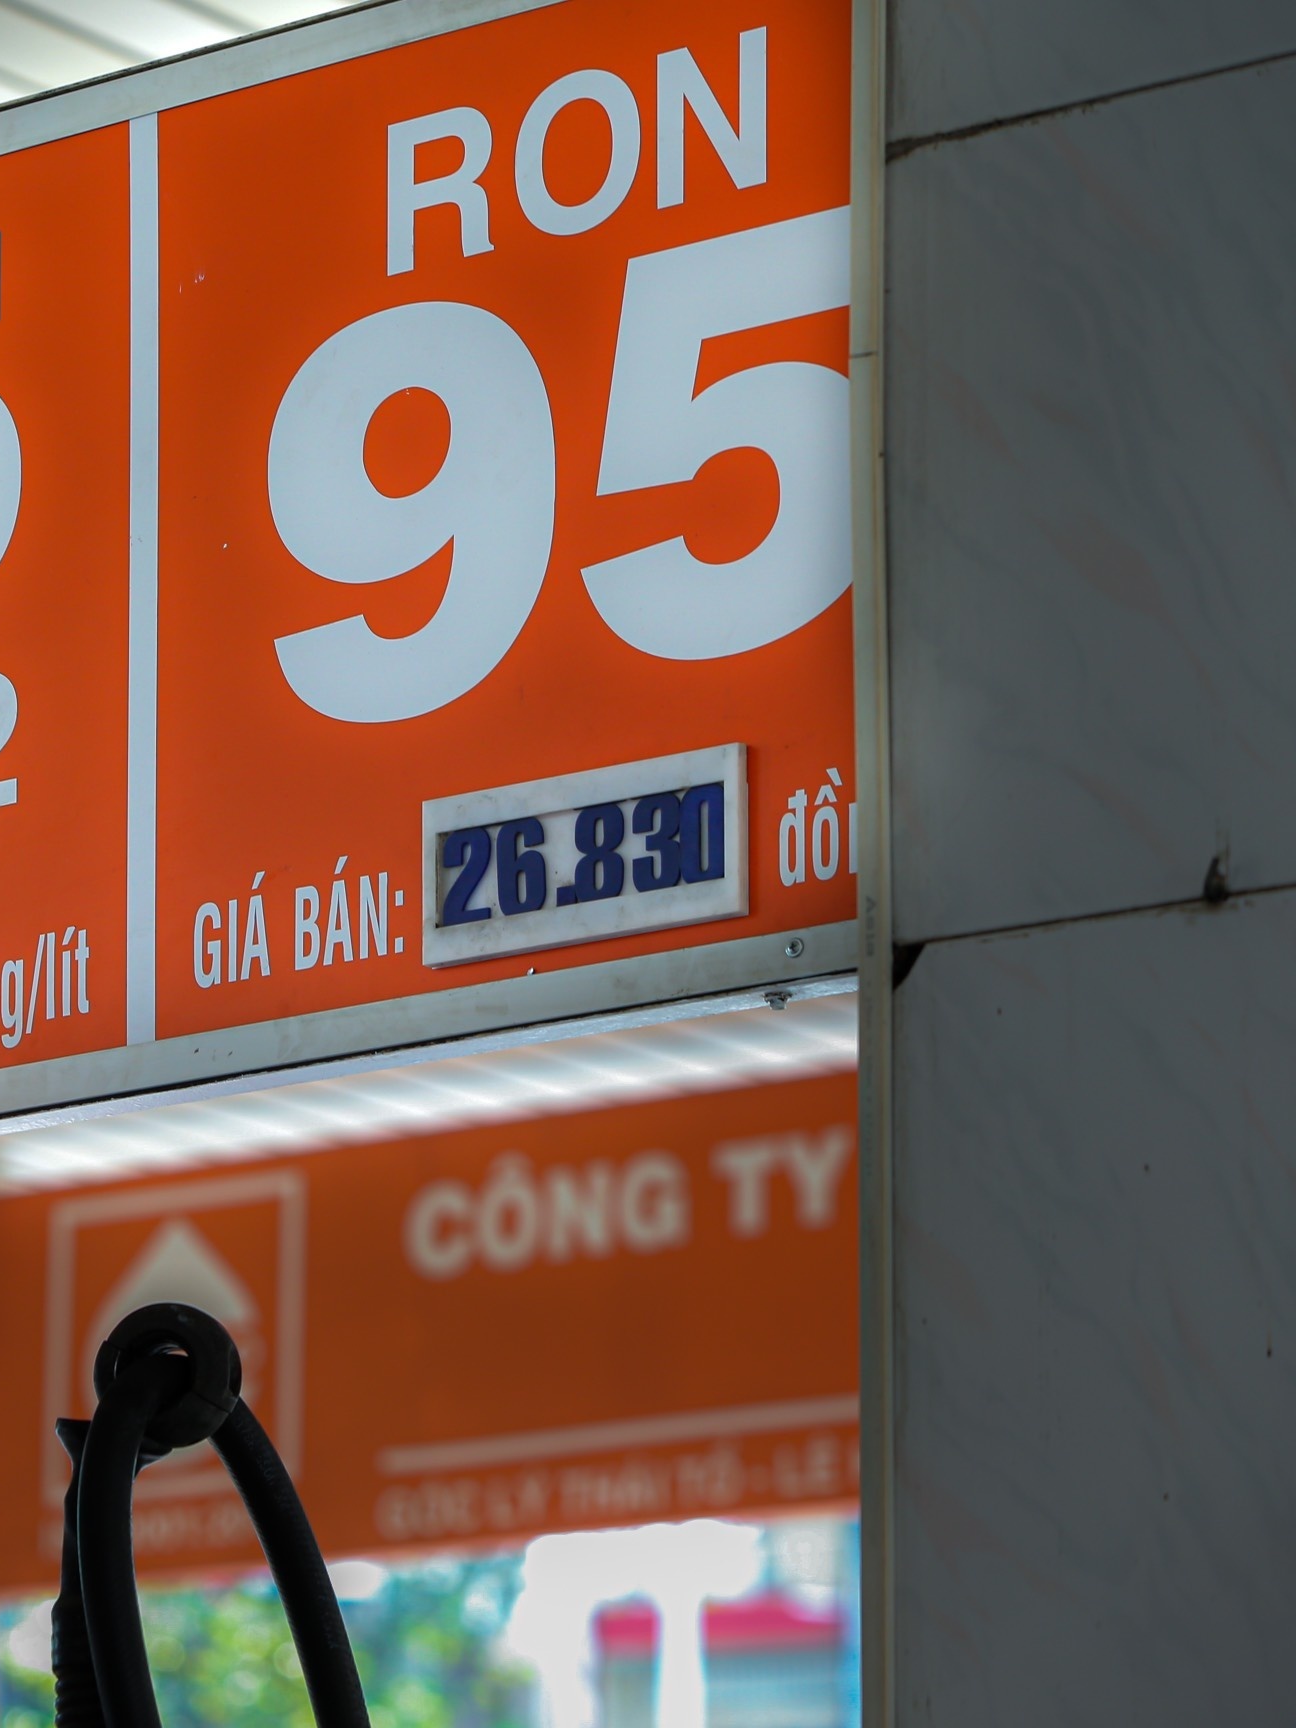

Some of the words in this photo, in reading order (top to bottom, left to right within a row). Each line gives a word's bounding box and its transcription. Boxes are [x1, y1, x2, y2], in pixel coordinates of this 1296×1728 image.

[387, 26, 767, 276] RON
[267, 204, 853, 724] 95
[193, 870, 271, 989] GIÁ
[294, 855, 405, 971] BÁN:
[441, 783, 726, 927] 26.830
[405, 1148, 690, 1281] CÔNG
[715, 1126, 853, 1237] TY
